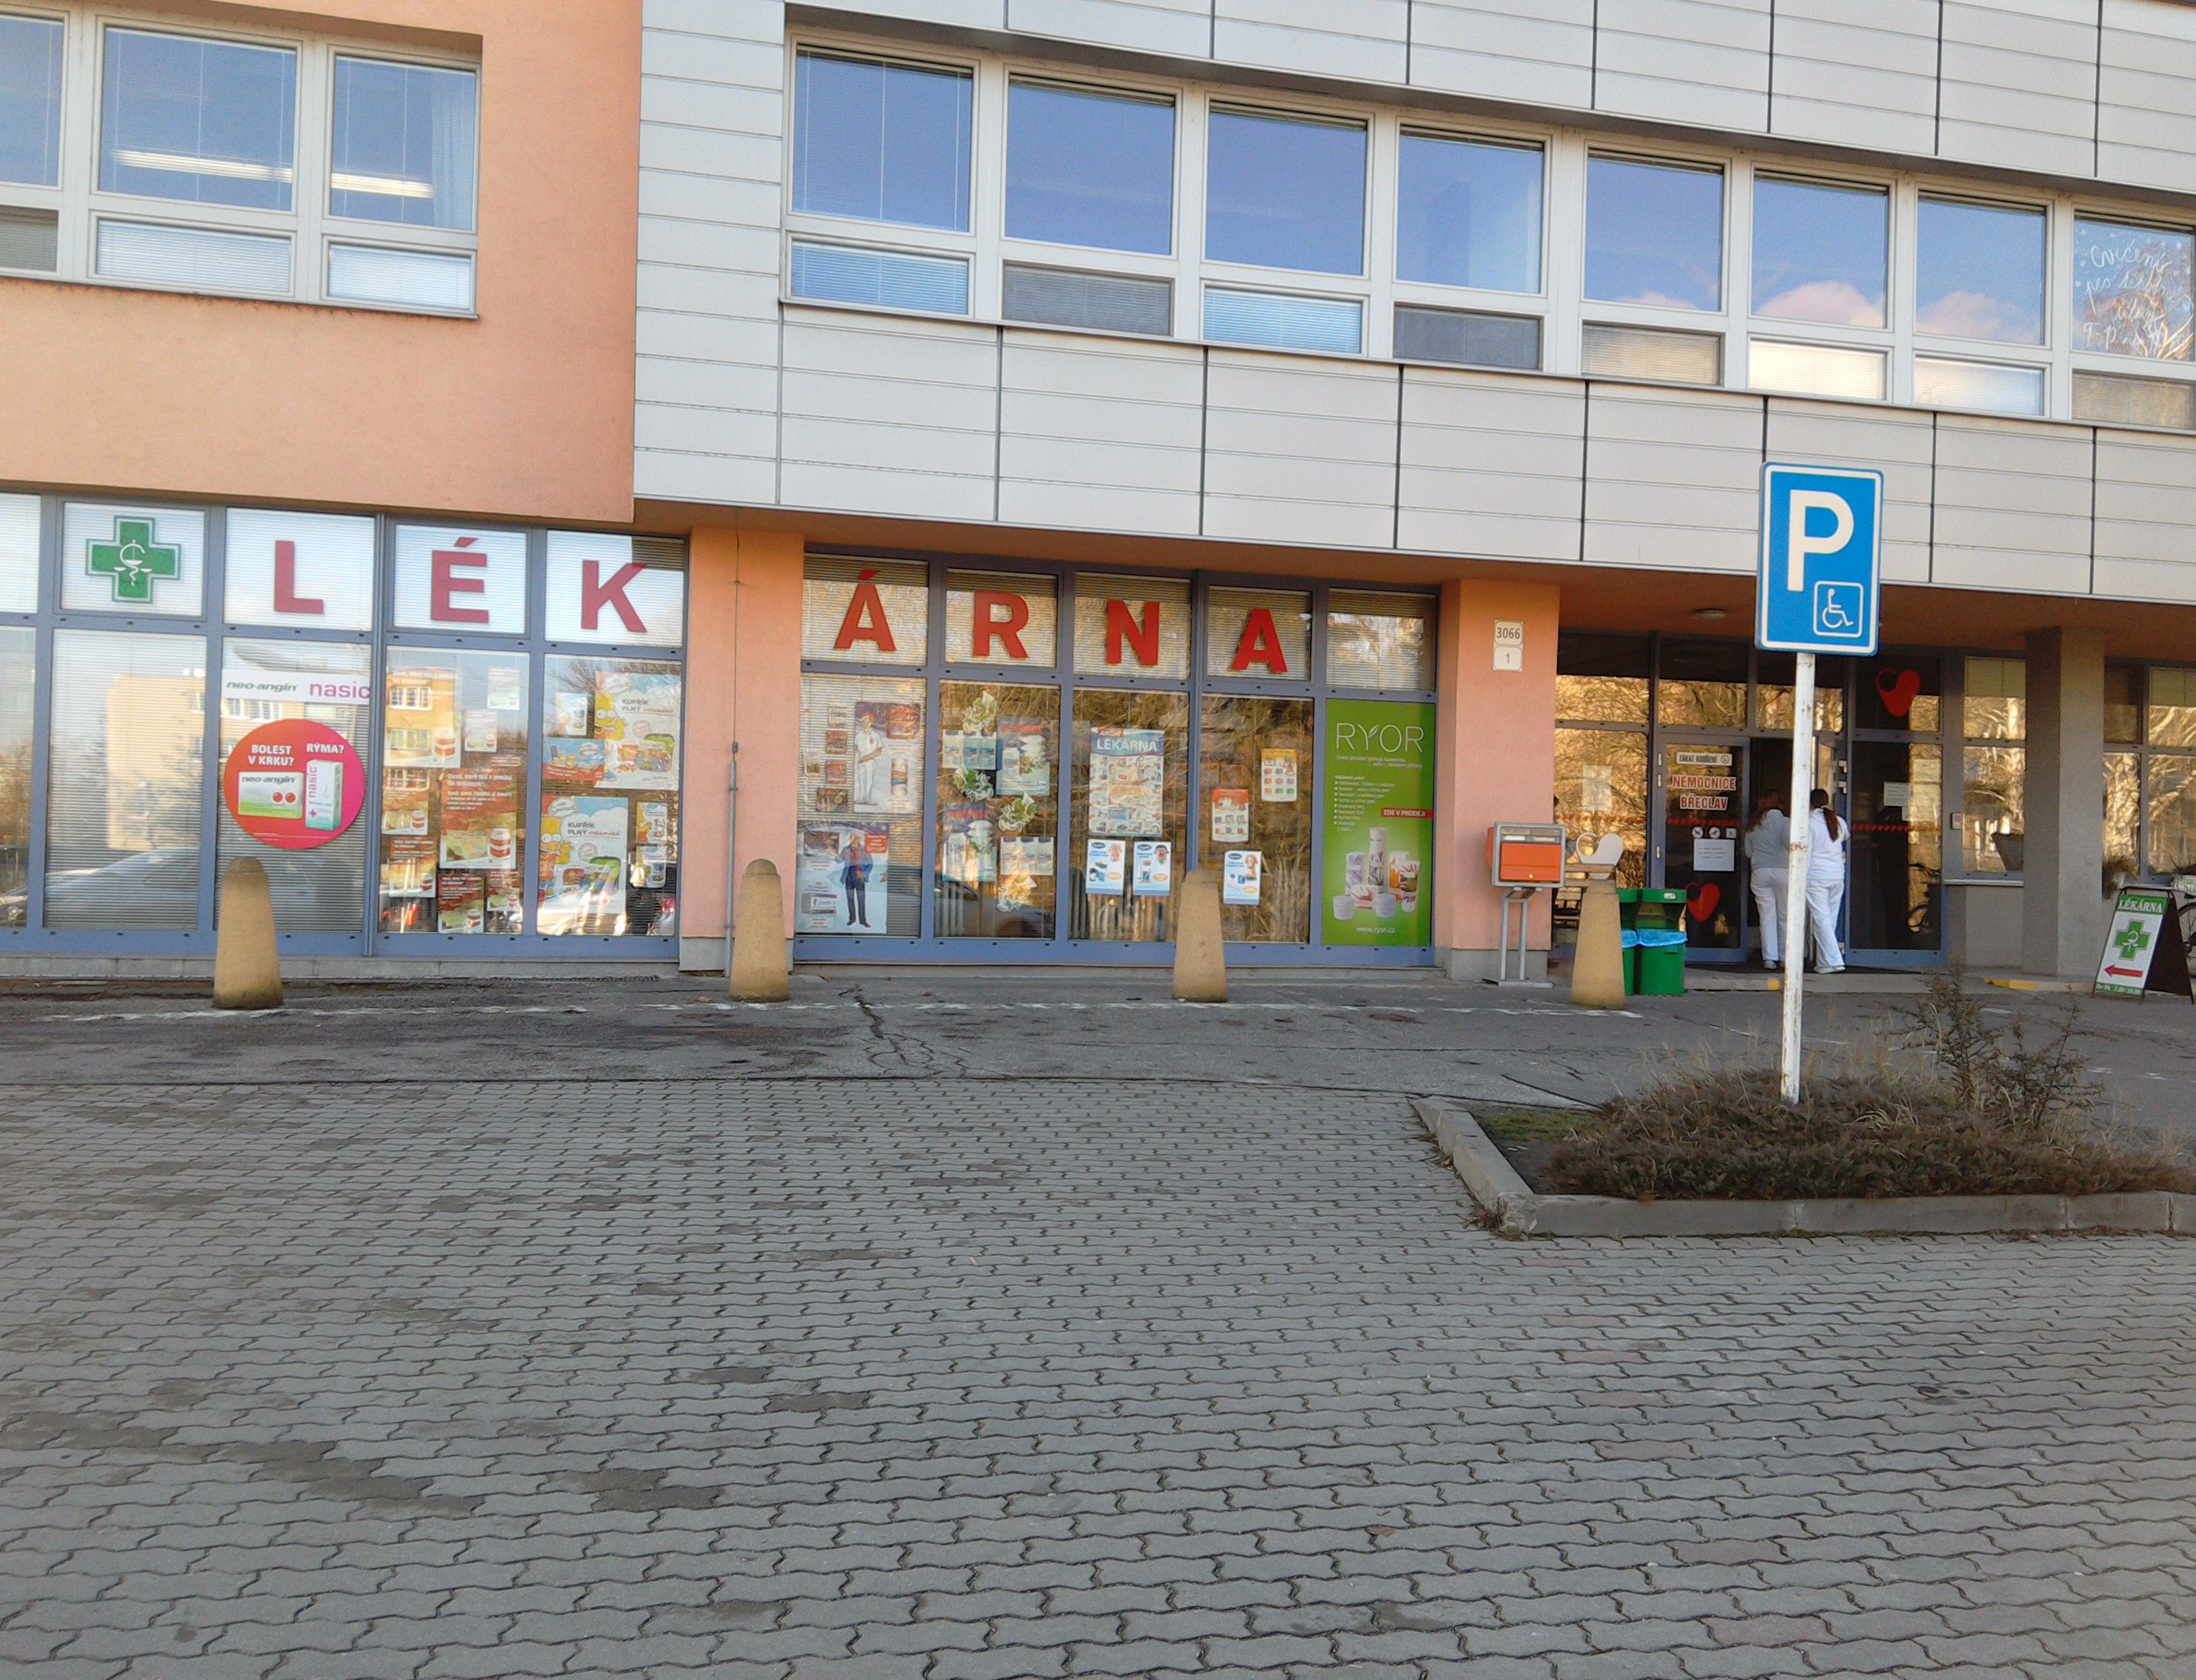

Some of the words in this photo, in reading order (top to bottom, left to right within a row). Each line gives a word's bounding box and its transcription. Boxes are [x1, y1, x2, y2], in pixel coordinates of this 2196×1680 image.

[1788, 489, 1854, 592] P
[1496, 627, 1521, 640] 3066
[1505, 653, 1510, 664] 1
[309, 681, 371, 699] nasic
[1336, 723, 1425, 754] RYOR
[251, 744, 292, 755] BOLEST
[306, 743, 344, 754] RÝMA?
[248, 756, 256, 765] V
[259, 756, 294, 767] KRKU?
[308, 766, 317, 798] nasic
[1673, 775, 1736, 790] NEMOCNICE
[1681, 793, 1728, 809] BŘECLAV
[2118, 899, 2163, 913] LÉKÁRNA
